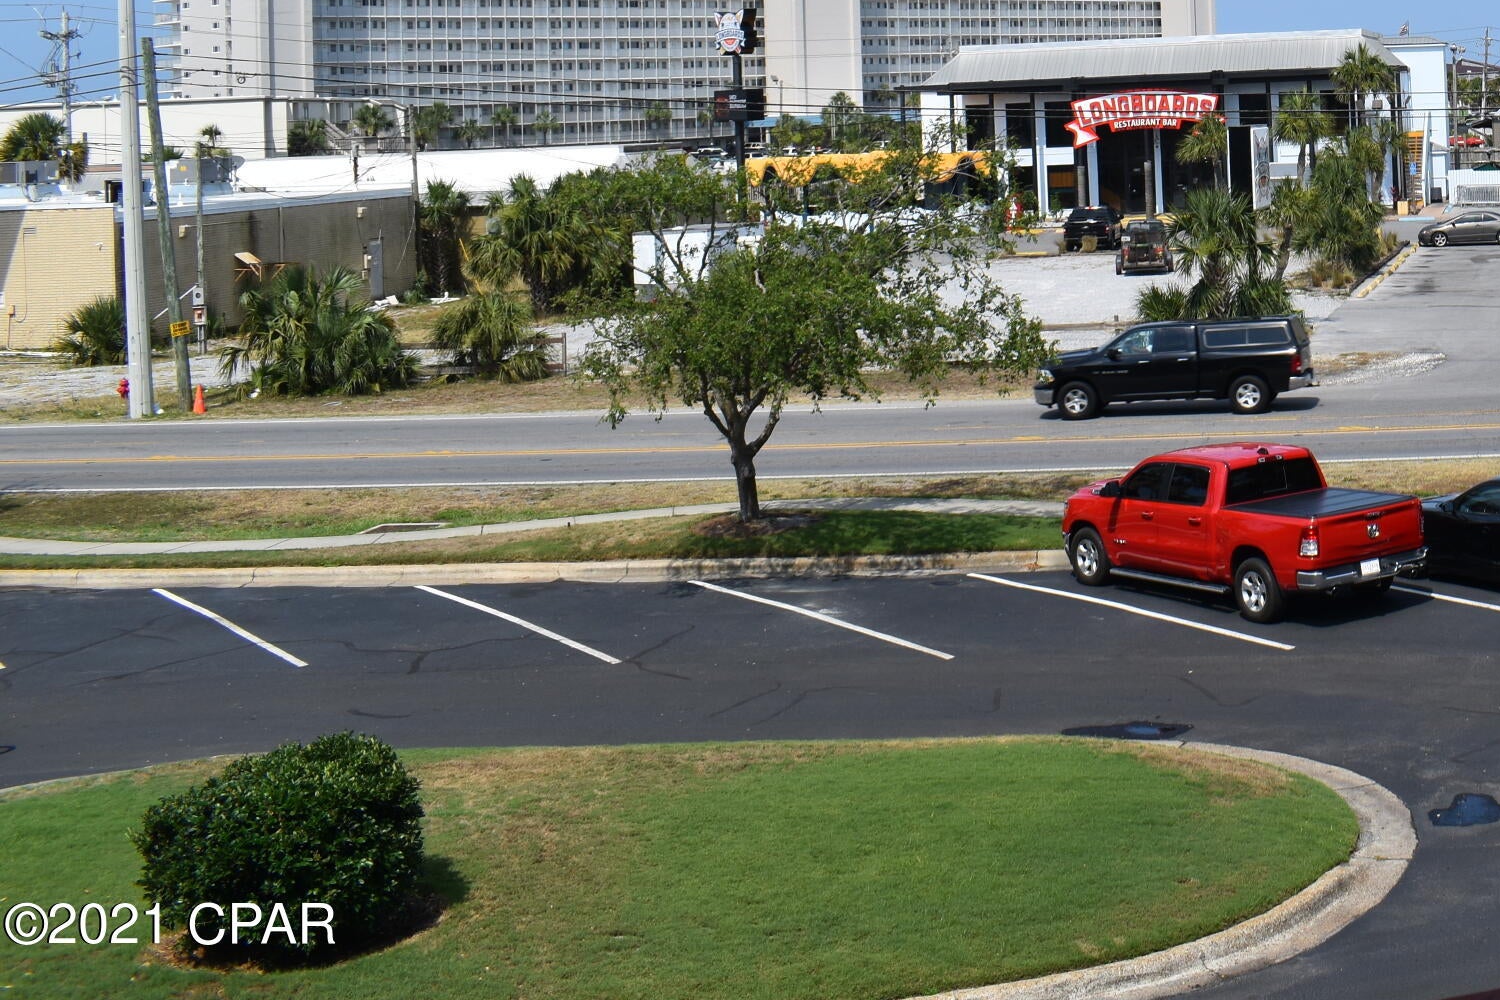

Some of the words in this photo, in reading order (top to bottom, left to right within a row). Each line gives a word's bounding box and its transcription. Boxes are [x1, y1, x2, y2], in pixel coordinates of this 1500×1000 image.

[1078, 94, 1213, 124] LONGBOARDS
[1114, 118, 1160, 129] RESTAURANT
[1162, 118, 1177, 127] BAR
